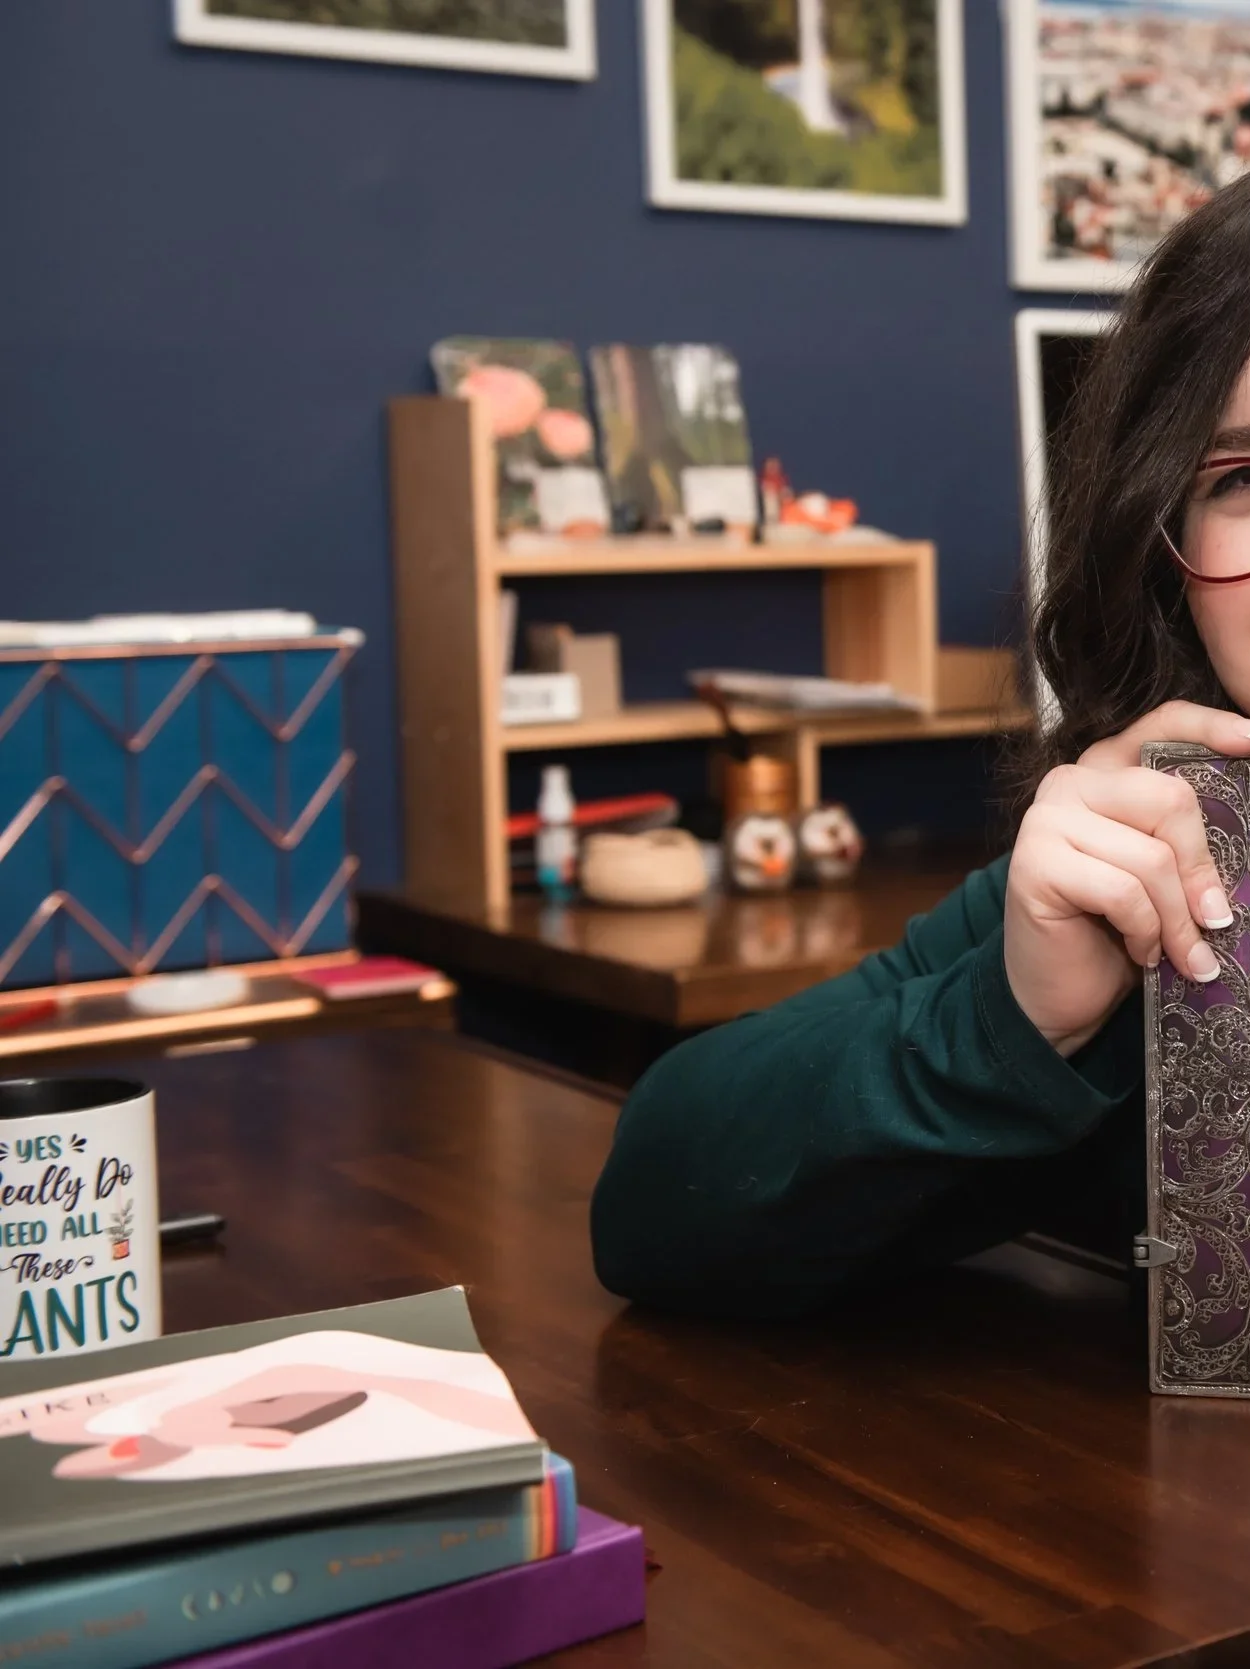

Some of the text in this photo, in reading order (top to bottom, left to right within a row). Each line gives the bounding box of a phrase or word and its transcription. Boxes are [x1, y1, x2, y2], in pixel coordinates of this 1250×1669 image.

[15, 1134, 62, 1163] YES
[0, 1157, 133, 1212] eally Do
[0, 1212, 103, 1248] EED ALL
[0, 1253, 93, 1283] These
[0, 1270, 140, 1356] ANTS
[0, 1392, 111, 1426] IKE
